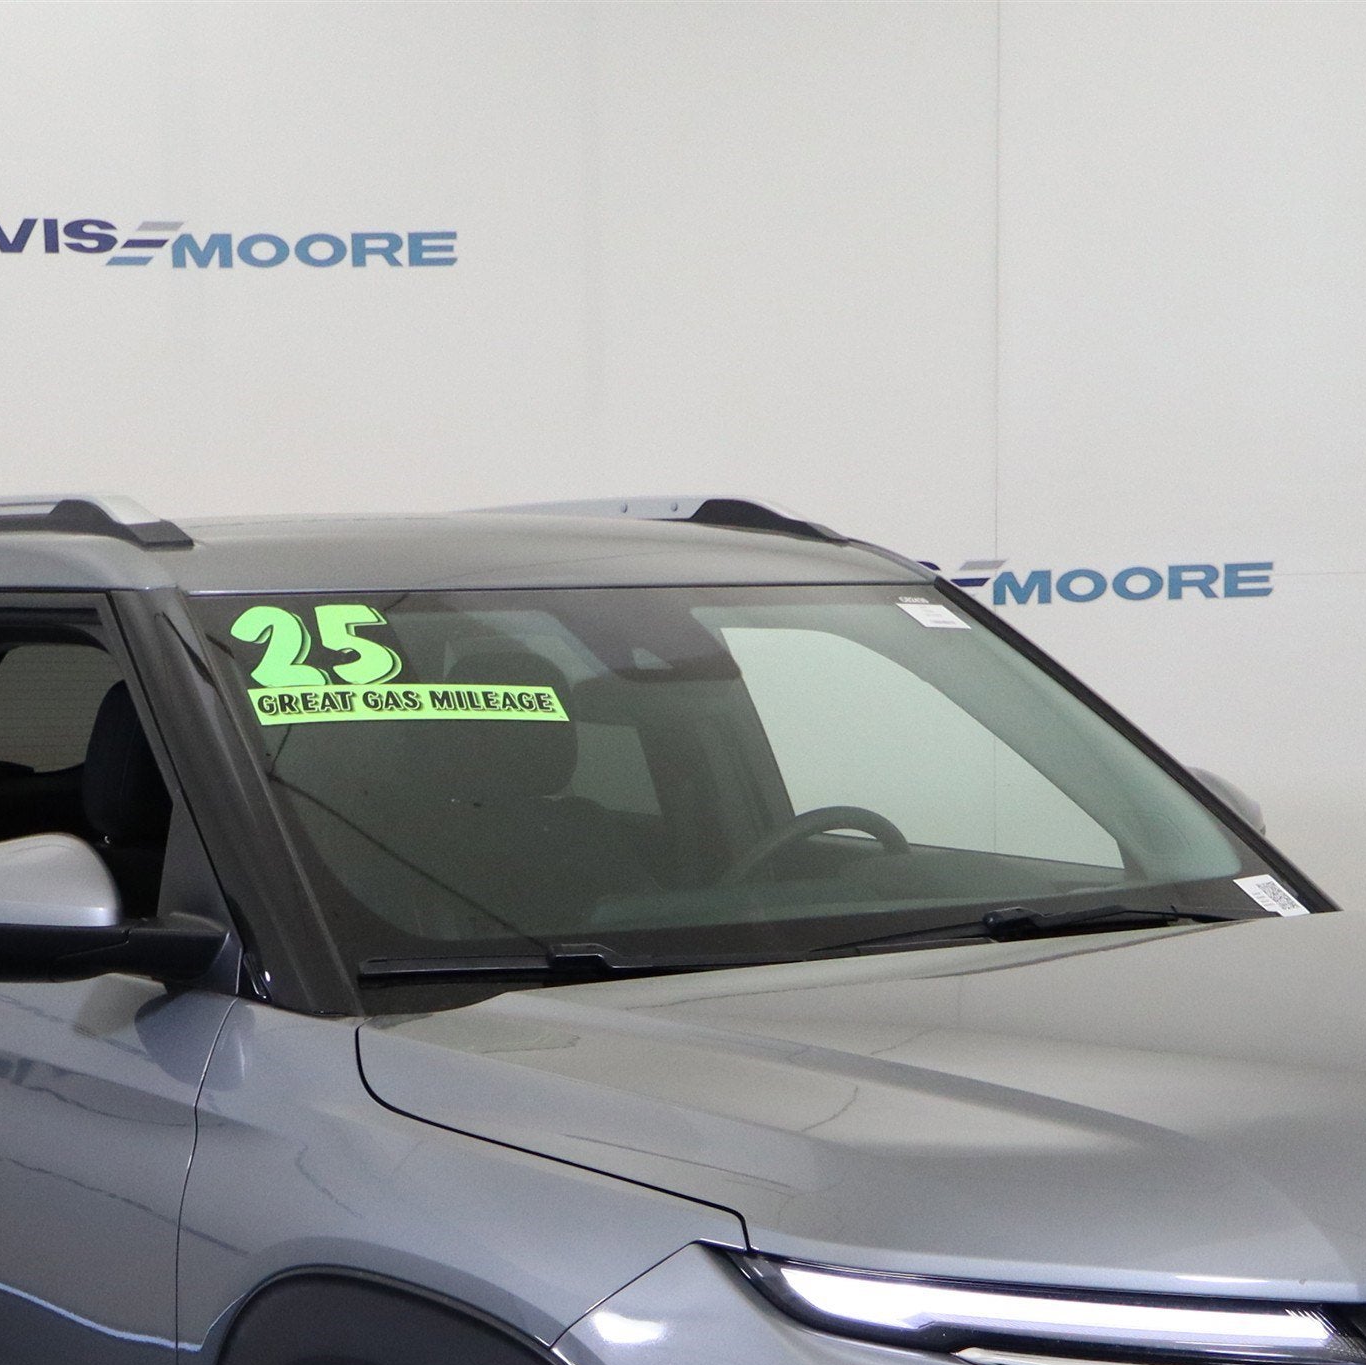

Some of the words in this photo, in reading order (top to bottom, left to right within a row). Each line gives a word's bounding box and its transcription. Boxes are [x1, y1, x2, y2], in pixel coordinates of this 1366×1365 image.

[172, 232, 458, 268] MOORE
[992, 561, 1274, 607] MOORE
[230, 604, 403, 687] 25
[257, 690, 355, 716] GREAT
[363, 688, 431, 712] GAS
[429, 689, 557, 713] MILEAGE
